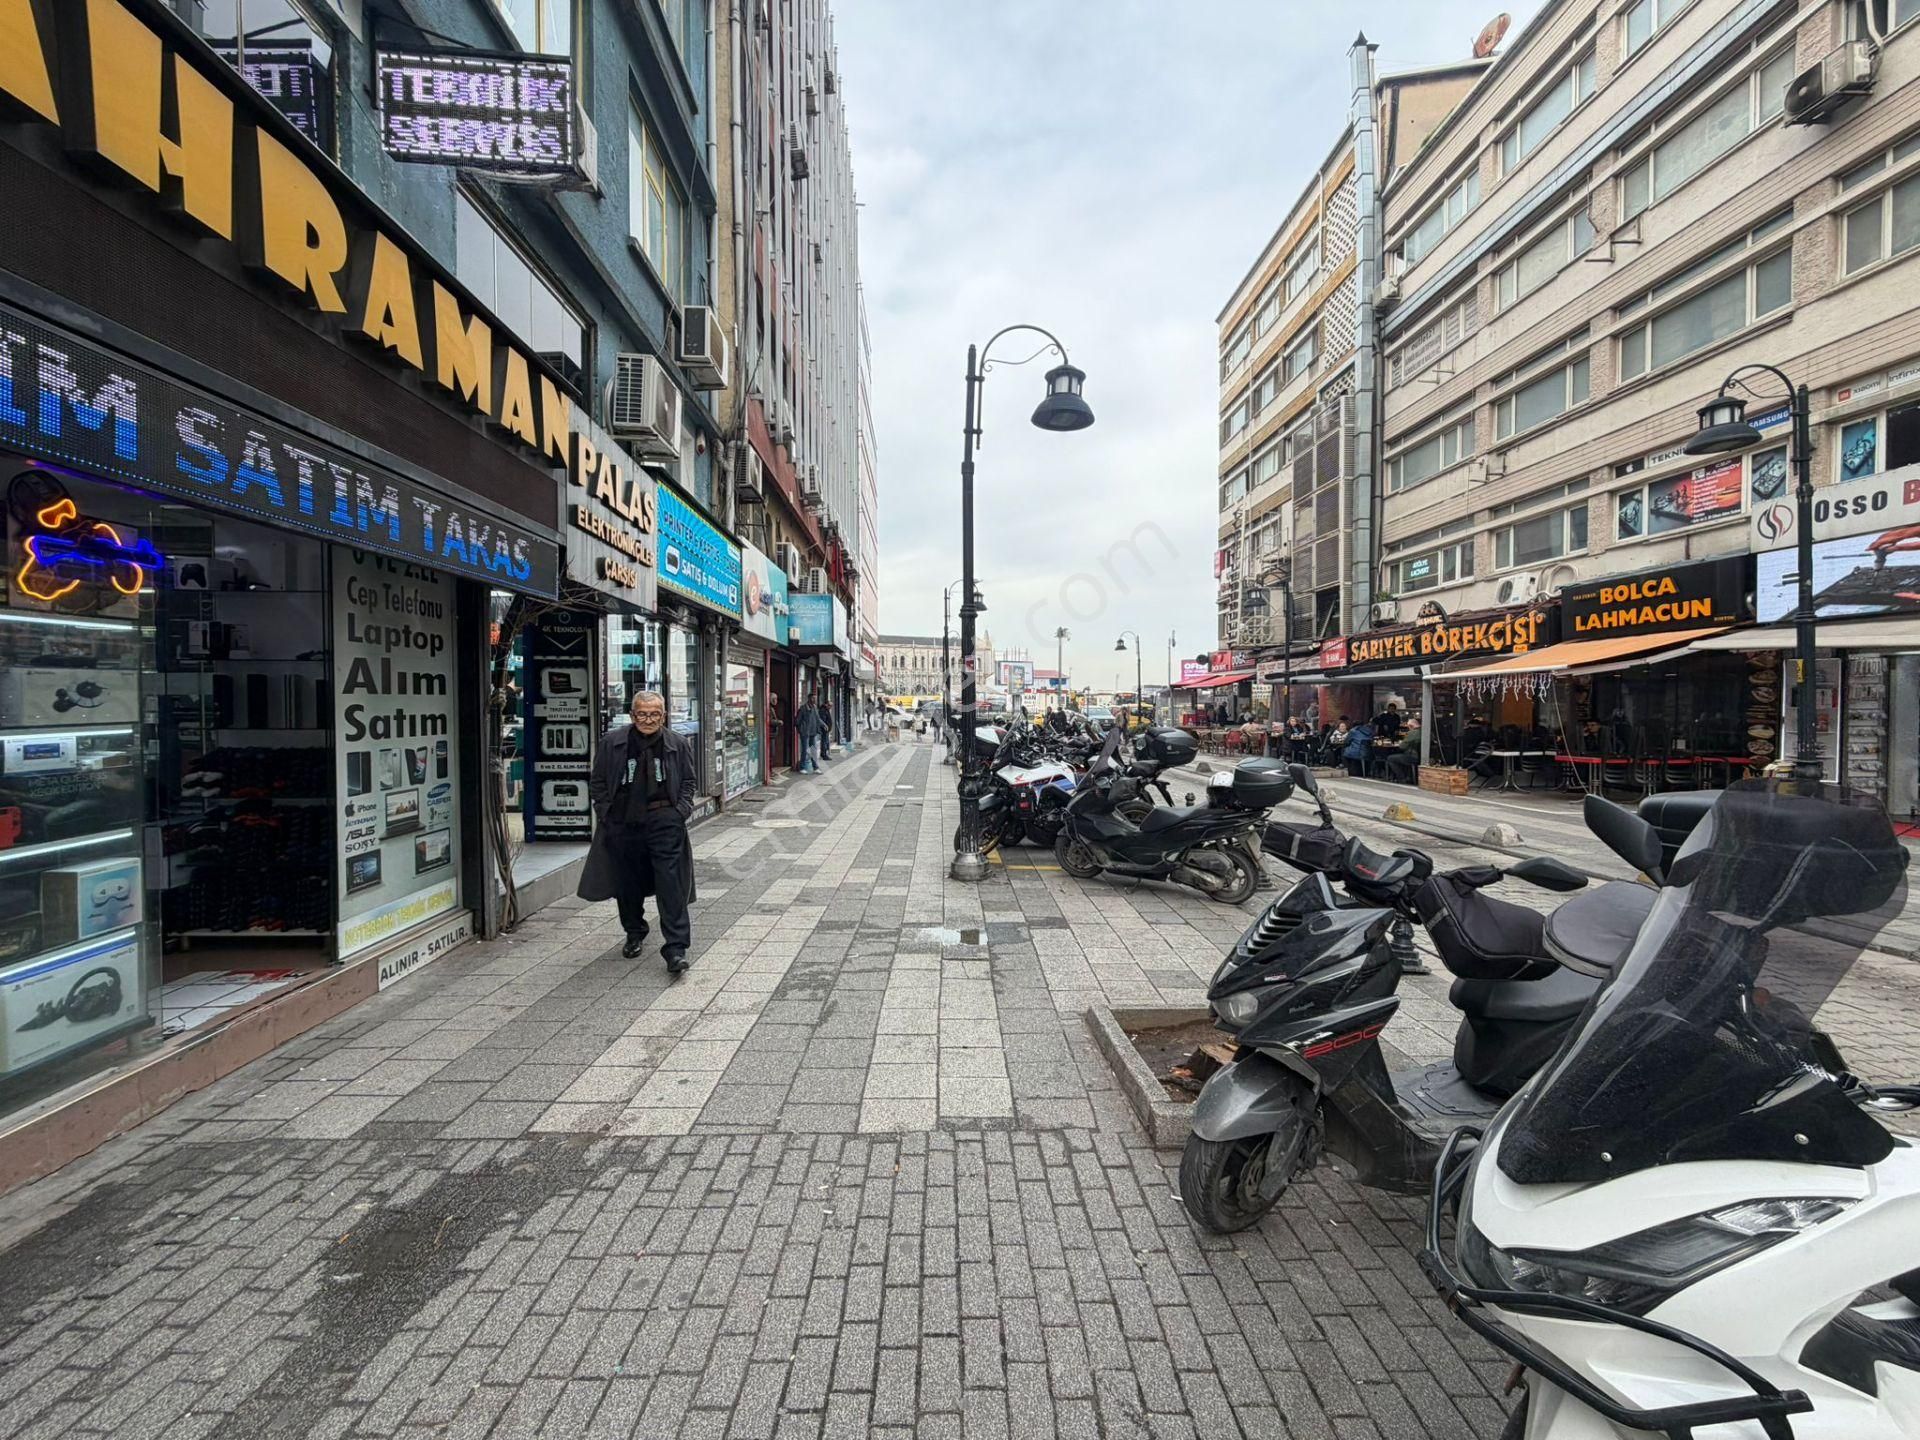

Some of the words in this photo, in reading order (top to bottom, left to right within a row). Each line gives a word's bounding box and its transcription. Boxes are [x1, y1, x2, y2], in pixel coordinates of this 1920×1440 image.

[1651, 446, 1688, 465] TEKNİ
[175, 405, 401, 542] SATIM
[412, 496, 532, 581] TAKAS
[577, 431, 655, 535] PALAS
[346, 575, 378, 614] Cep
[382, 582, 443, 620] Telefonu
[1599, 576, 1678, 605] BOLCA
[1575, 597, 1712, 632] LAHMACUN
[347, 612, 444, 658] Laptop
[1351, 633, 1416, 662] SARIYER
[342, 657, 447, 696] Alım
[344, 703, 448, 742] Satım
[345, 825, 376, 842] ASUS
[345, 837, 377, 854] SONY
[380, 950, 419, 983] ALINIR
[427, 926, 469, 957] SATILIR.
